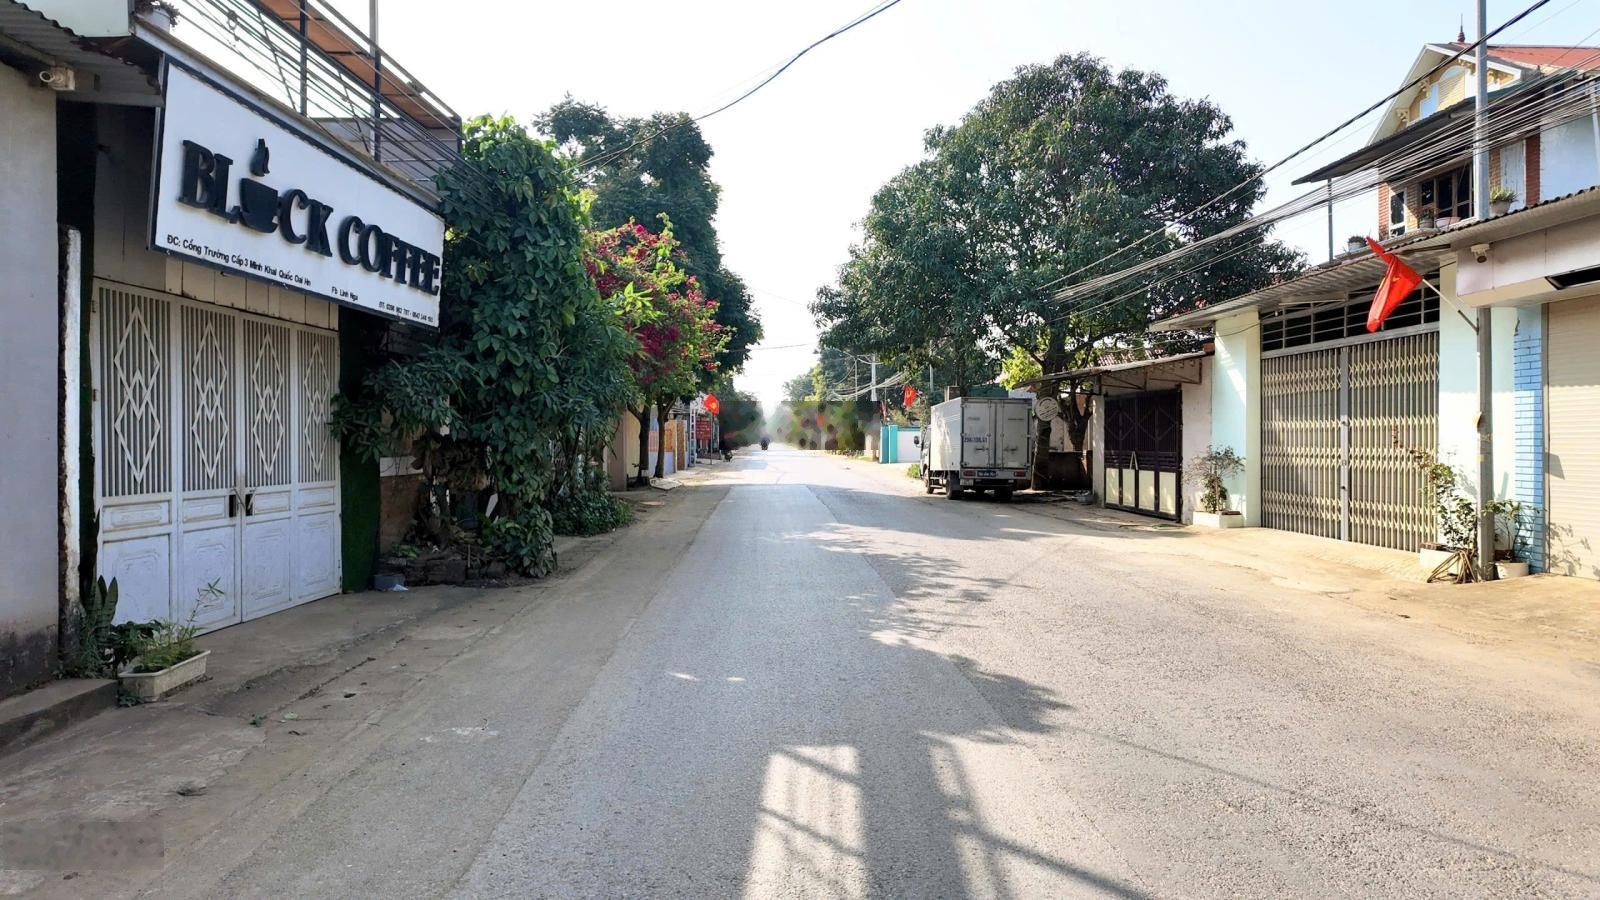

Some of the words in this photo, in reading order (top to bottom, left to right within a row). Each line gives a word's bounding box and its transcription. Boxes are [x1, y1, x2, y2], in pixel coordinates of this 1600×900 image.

[167, 234, 181, 247] ĐC:
[250, 259, 263, 272] Minh
[264, 265, 277, 277] Khai
[337, 215, 441, 297] COFFEE
